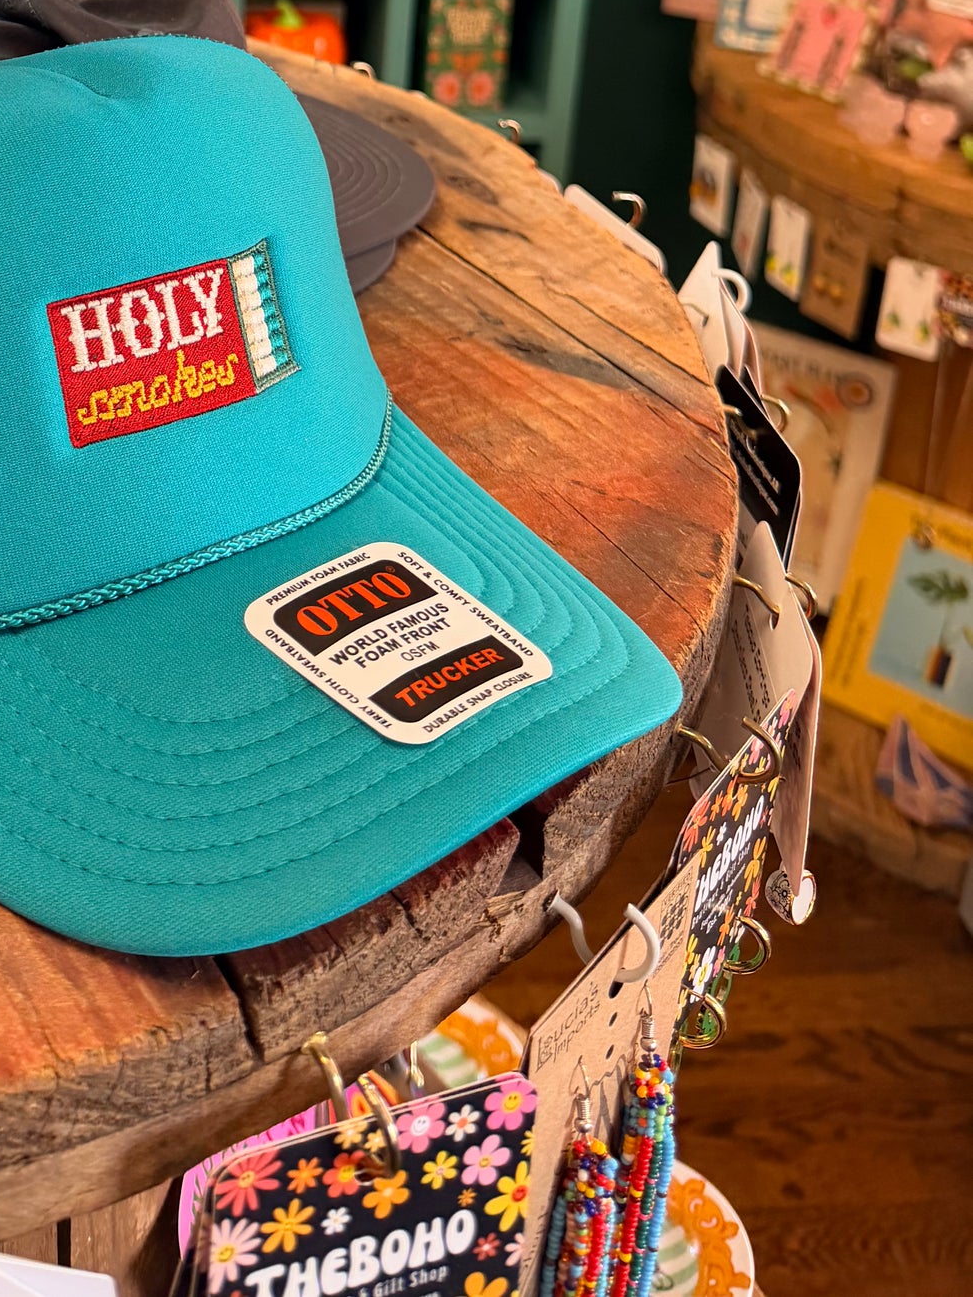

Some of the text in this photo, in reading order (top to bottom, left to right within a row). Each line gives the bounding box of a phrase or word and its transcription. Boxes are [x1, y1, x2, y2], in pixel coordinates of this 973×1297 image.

[61, 268, 224, 373] HOLY
[77, 349, 239, 425] smokes
[266, 552, 371, 606] PREMIUM FOAM FABRIC
[296, 572, 412, 636] OTTO
[397, 551, 534, 657] SOFT & COMFY SWEATBAND
[329, 602, 449, 666] WORLD FAMOUS
[354, 617, 451, 668] FOAM FRONT
[400, 641, 440, 662] OSFM
[265, 629, 393, 729] TERRY CLOTH SWEATBAND
[394, 648, 505, 708] TRUCKER
[422, 672, 533, 733] DURABLE SNAP CLOSURE
[552, 1001, 601, 1068] Imports
[244, 1209, 476, 1297] THEBOHO
[373, 1277, 404, 1297] Gift
[409, 1265, 449, 1288] Shop
